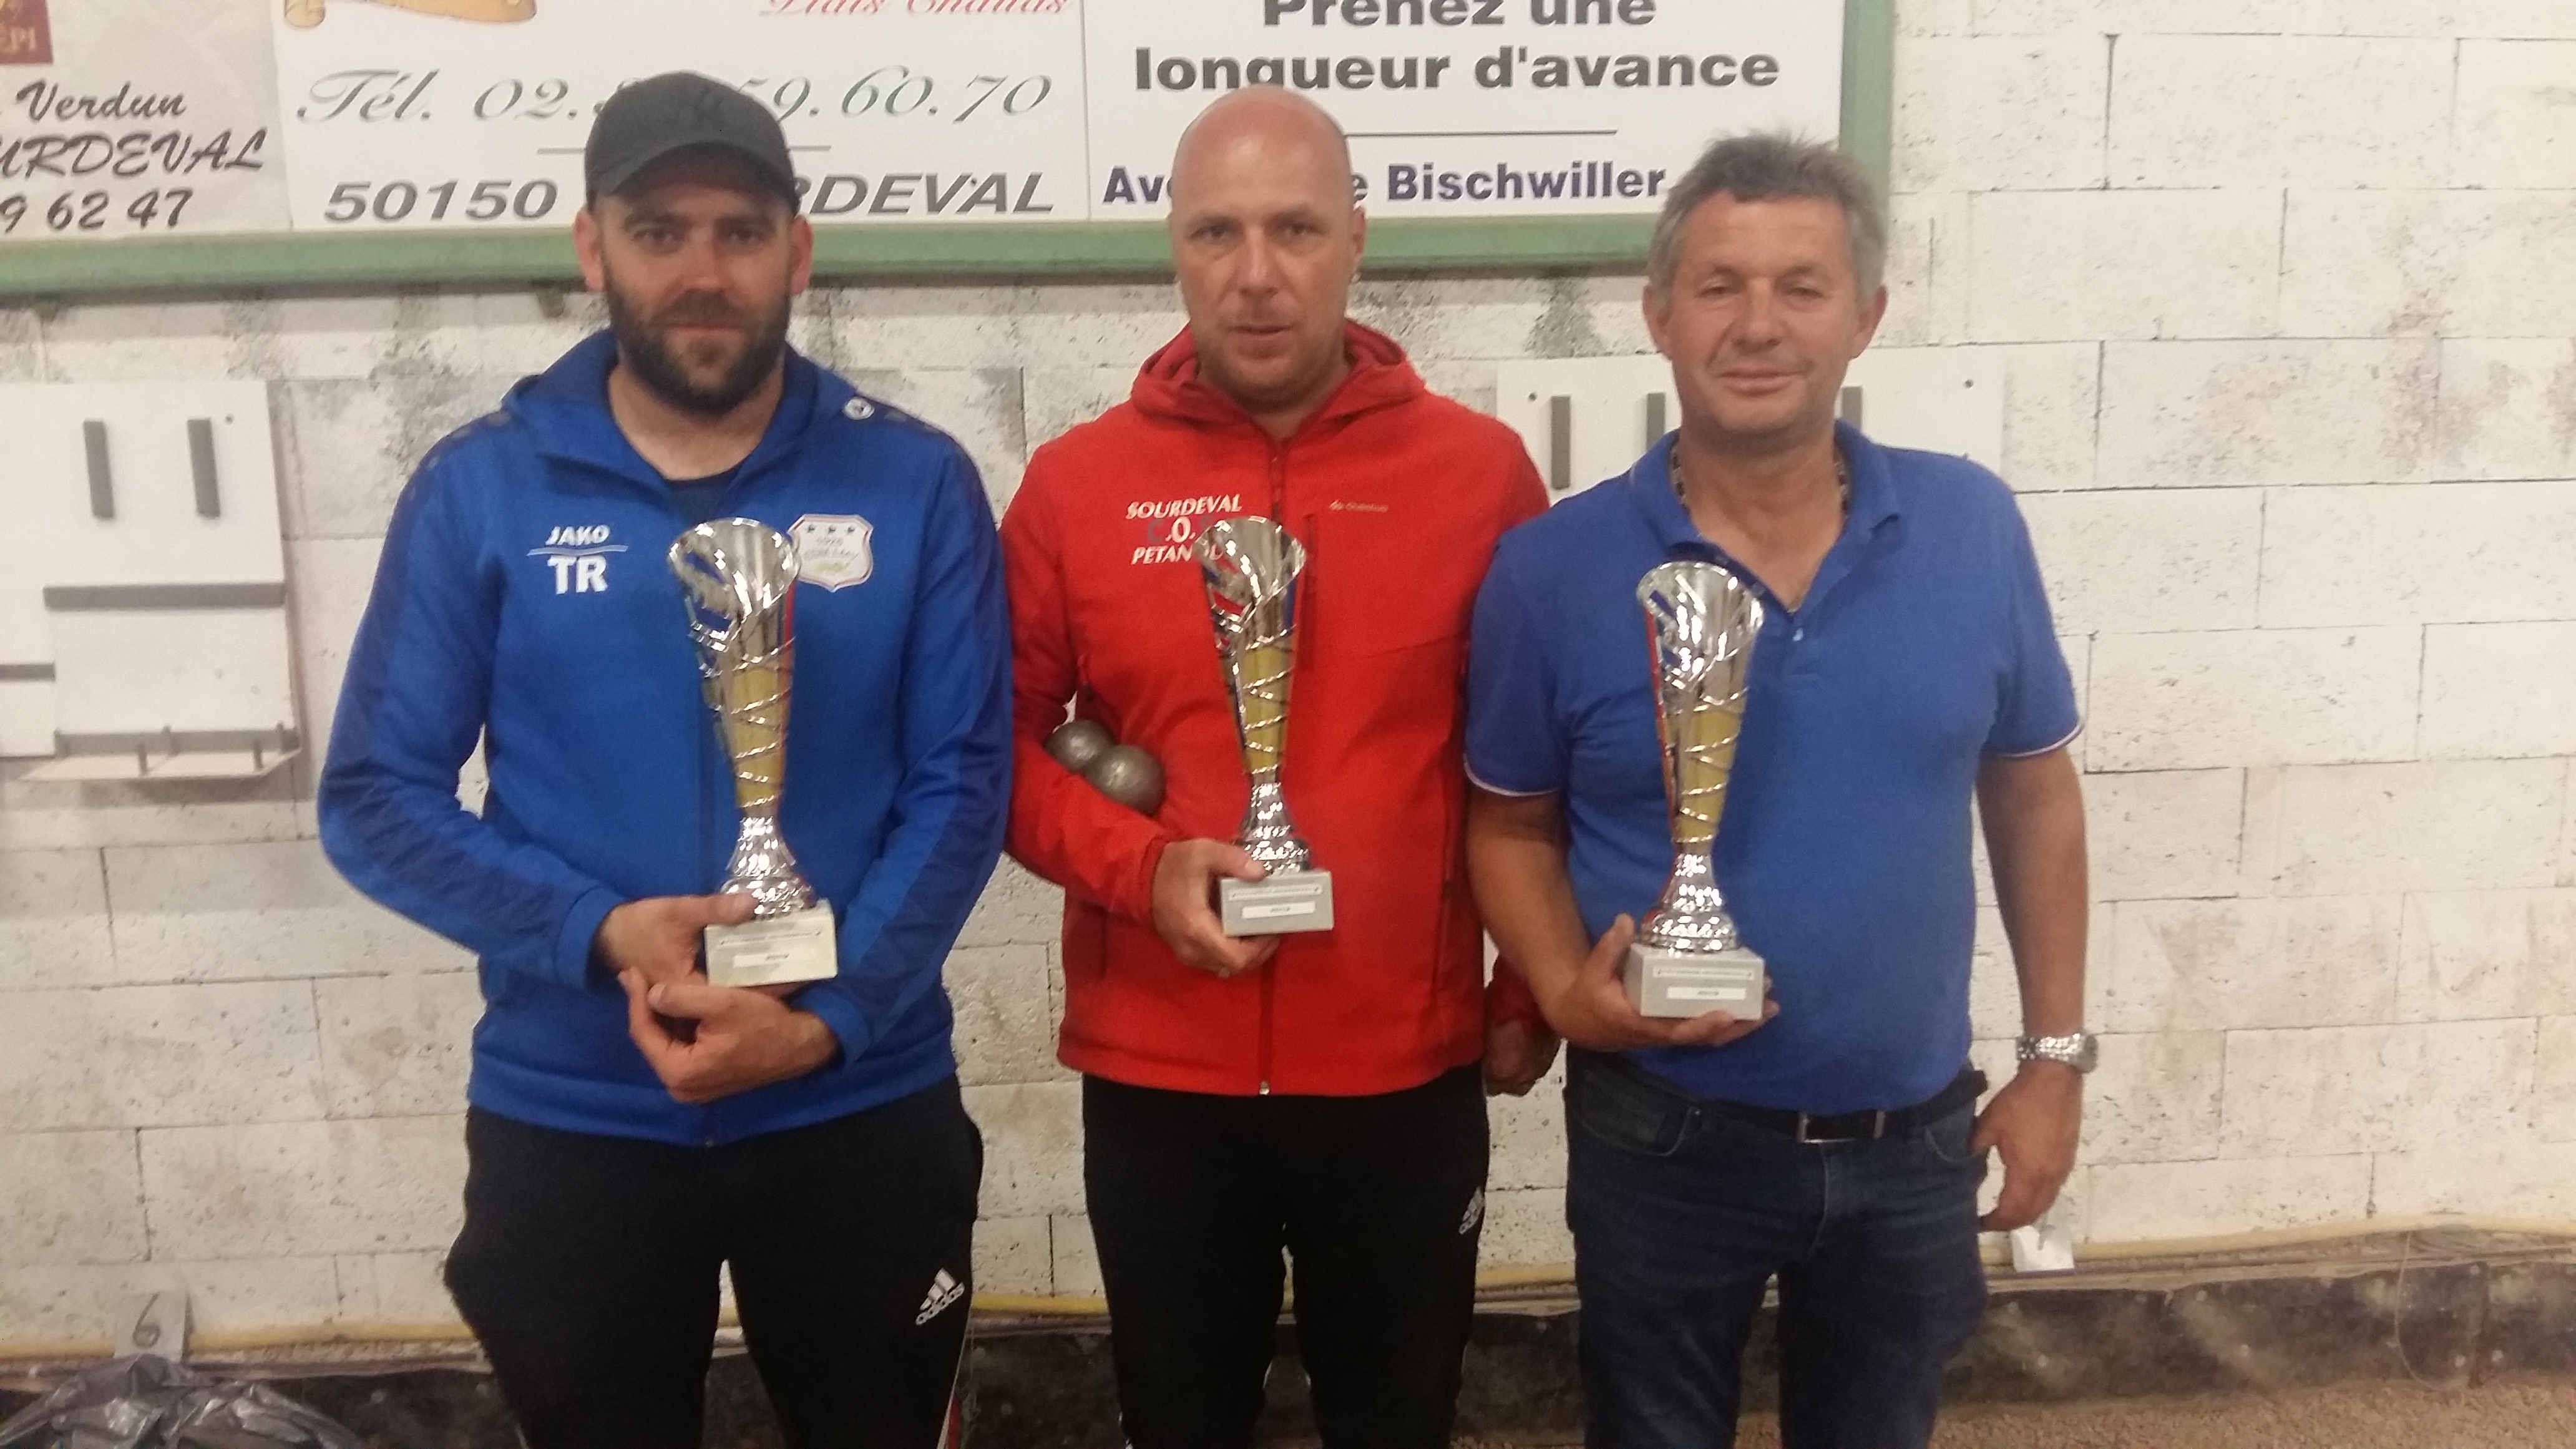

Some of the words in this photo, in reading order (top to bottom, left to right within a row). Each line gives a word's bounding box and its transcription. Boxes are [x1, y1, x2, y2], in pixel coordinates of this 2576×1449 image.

[1264, 0, 1505, 26] Prenez
[1532, 0, 1656, 25] une
[1134, 45, 1451, 90] longueur
[1475, 44, 1780, 88] d'avance
[16, 79, 187, 122] Verdun
[296, 69, 441, 121] Tél.
[324, 179, 559, 222] 50150
[1387, 160, 1666, 201] Bischwiller
[47, 190, 109, 230] 62
[127, 188, 193, 228] 47
[1125, 494, 1242, 520] SOURDEVAL
[545, 524, 610, 546] JAKO
[547, 554, 607, 594] TR
[132, 1292, 160, 1349] 6
